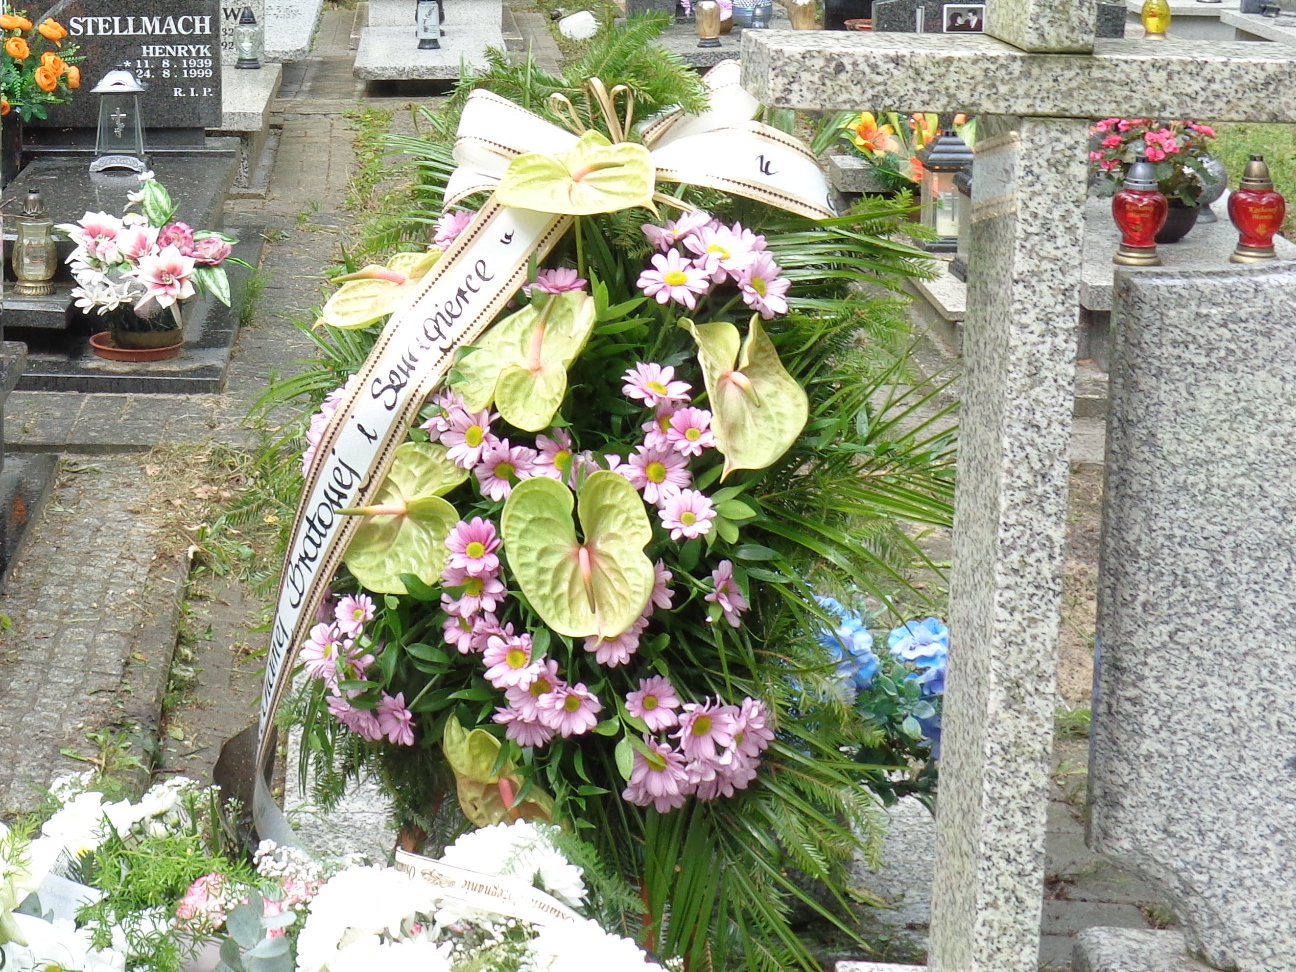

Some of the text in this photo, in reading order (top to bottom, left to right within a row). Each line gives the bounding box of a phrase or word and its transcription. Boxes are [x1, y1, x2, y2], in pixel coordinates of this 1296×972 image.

[69, 15, 212, 37] STELLMACH
[142, 44, 212, 57] HENRYK
[182, 59, 212, 68] 1939
[182, 69, 212, 78] 1999
[287, 448, 373, 610] Bratowej
